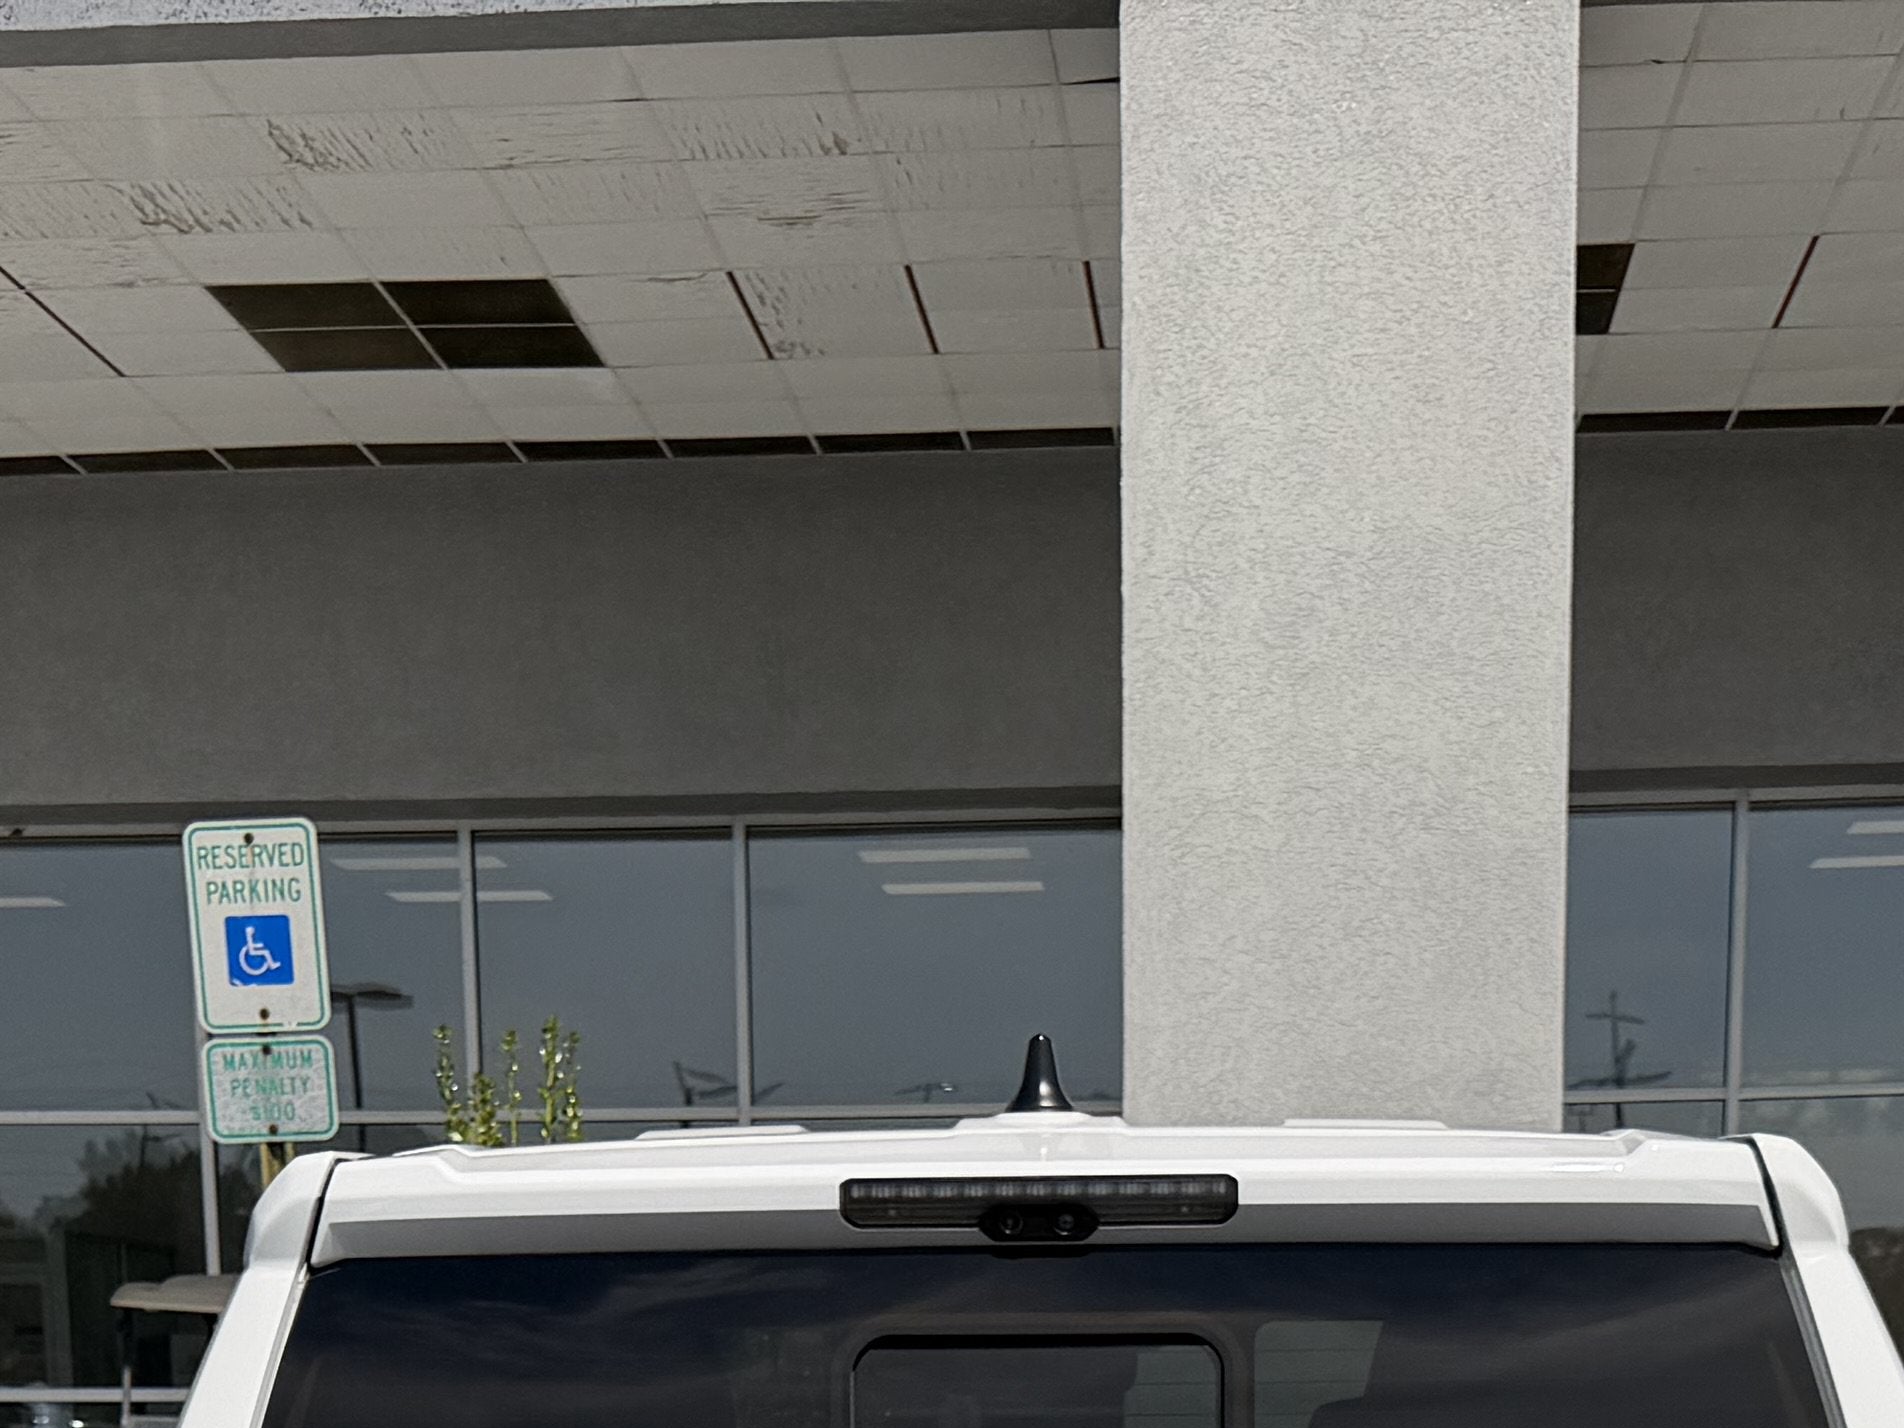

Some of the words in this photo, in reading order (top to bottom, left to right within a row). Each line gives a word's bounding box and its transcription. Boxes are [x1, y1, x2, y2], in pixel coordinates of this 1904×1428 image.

[197, 842, 305, 870] RESERVED
[206, 878, 302, 905] PARKING
[223, 1050, 313, 1073] MAXIMUM
[230, 1077, 312, 1098] PENALTY
